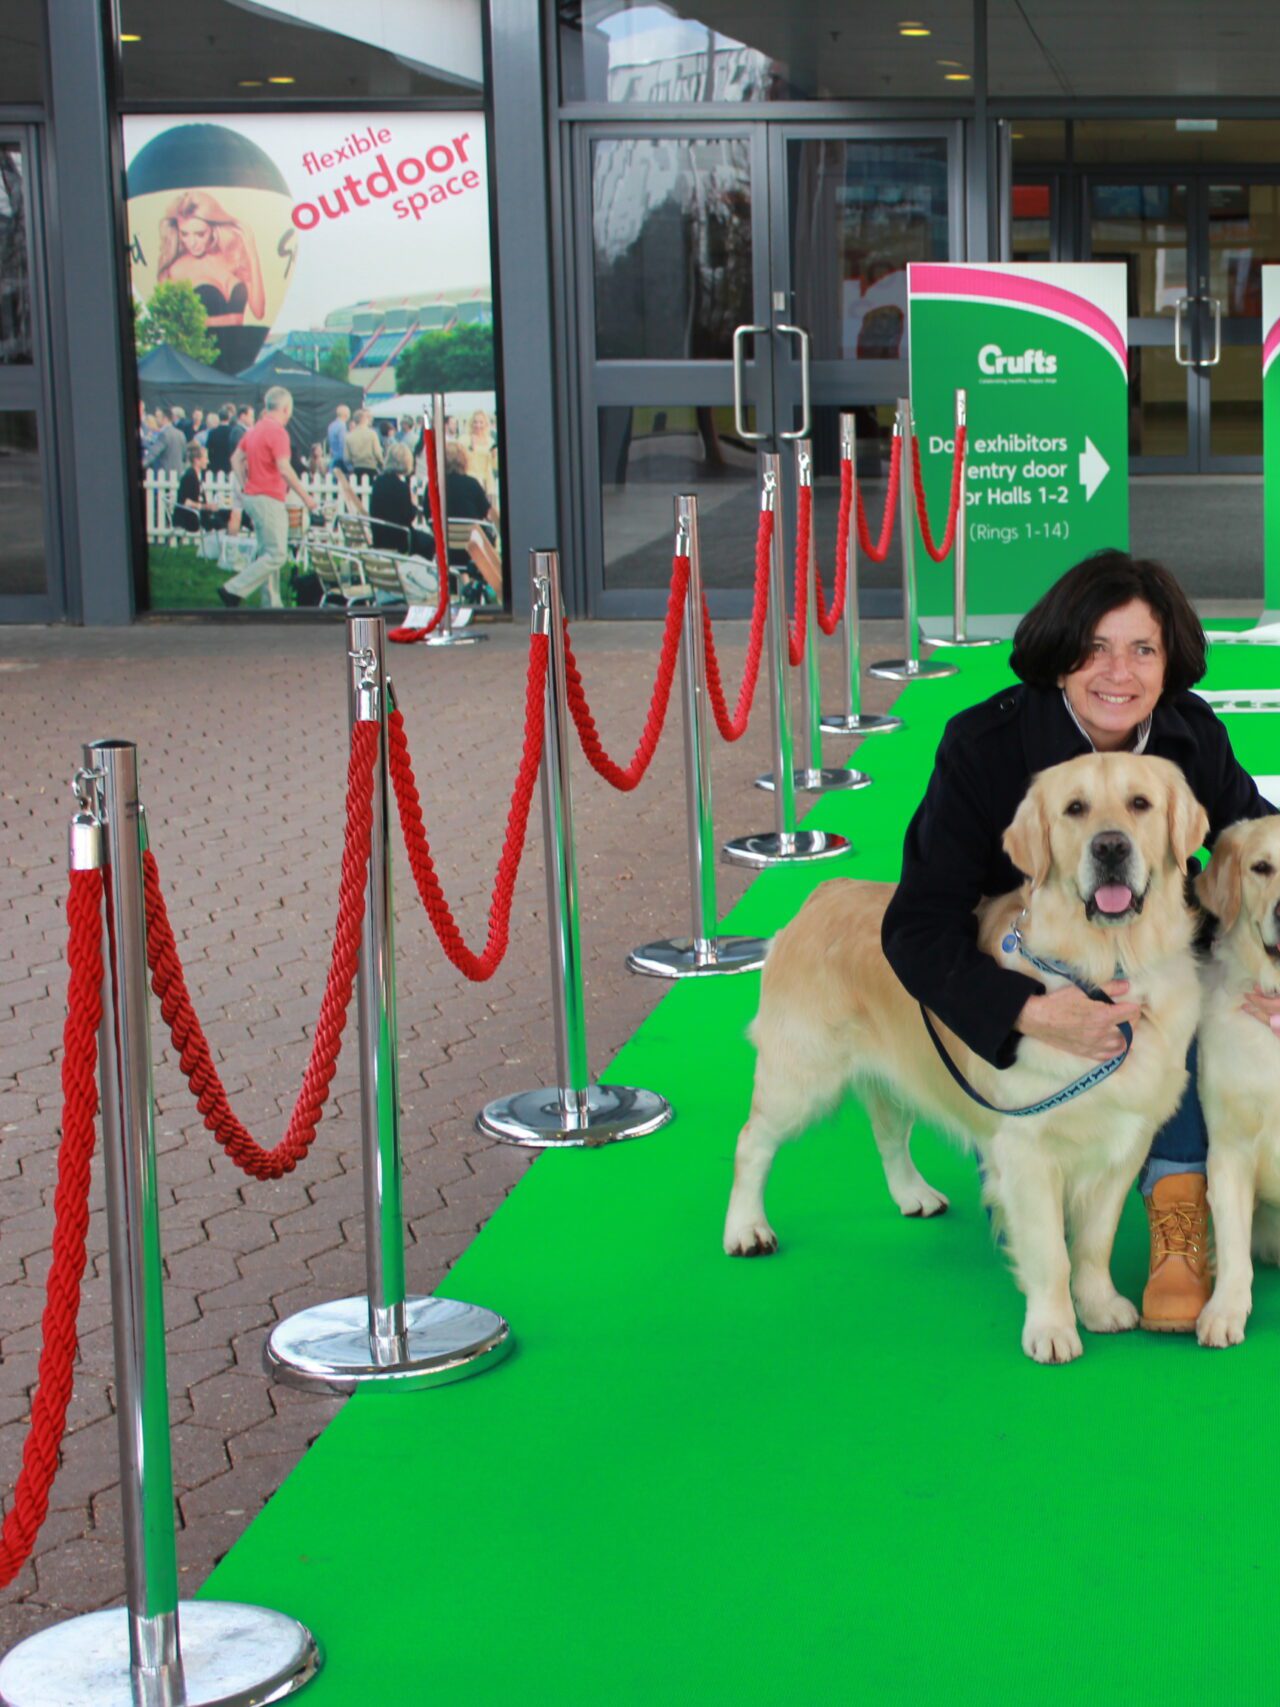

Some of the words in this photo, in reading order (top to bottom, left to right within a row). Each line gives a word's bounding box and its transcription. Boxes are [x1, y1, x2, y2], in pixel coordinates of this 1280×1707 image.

[302, 126, 392, 175] flexible
[291, 132, 471, 231] outdoor
[392, 169, 481, 222] space
[978, 344, 1058, 375] Crufts
[929, 436, 969, 455] Do
[974, 434, 1068, 453] exhibitors
[967, 462, 1017, 483] entry
[1022, 459, 1068, 478] door
[987, 486, 1032, 505] Halls
[1038, 486, 1069, 504] 1-2
[970, 523, 1019, 544] (Rings
[1025, 521, 1070, 540] 1-14)
